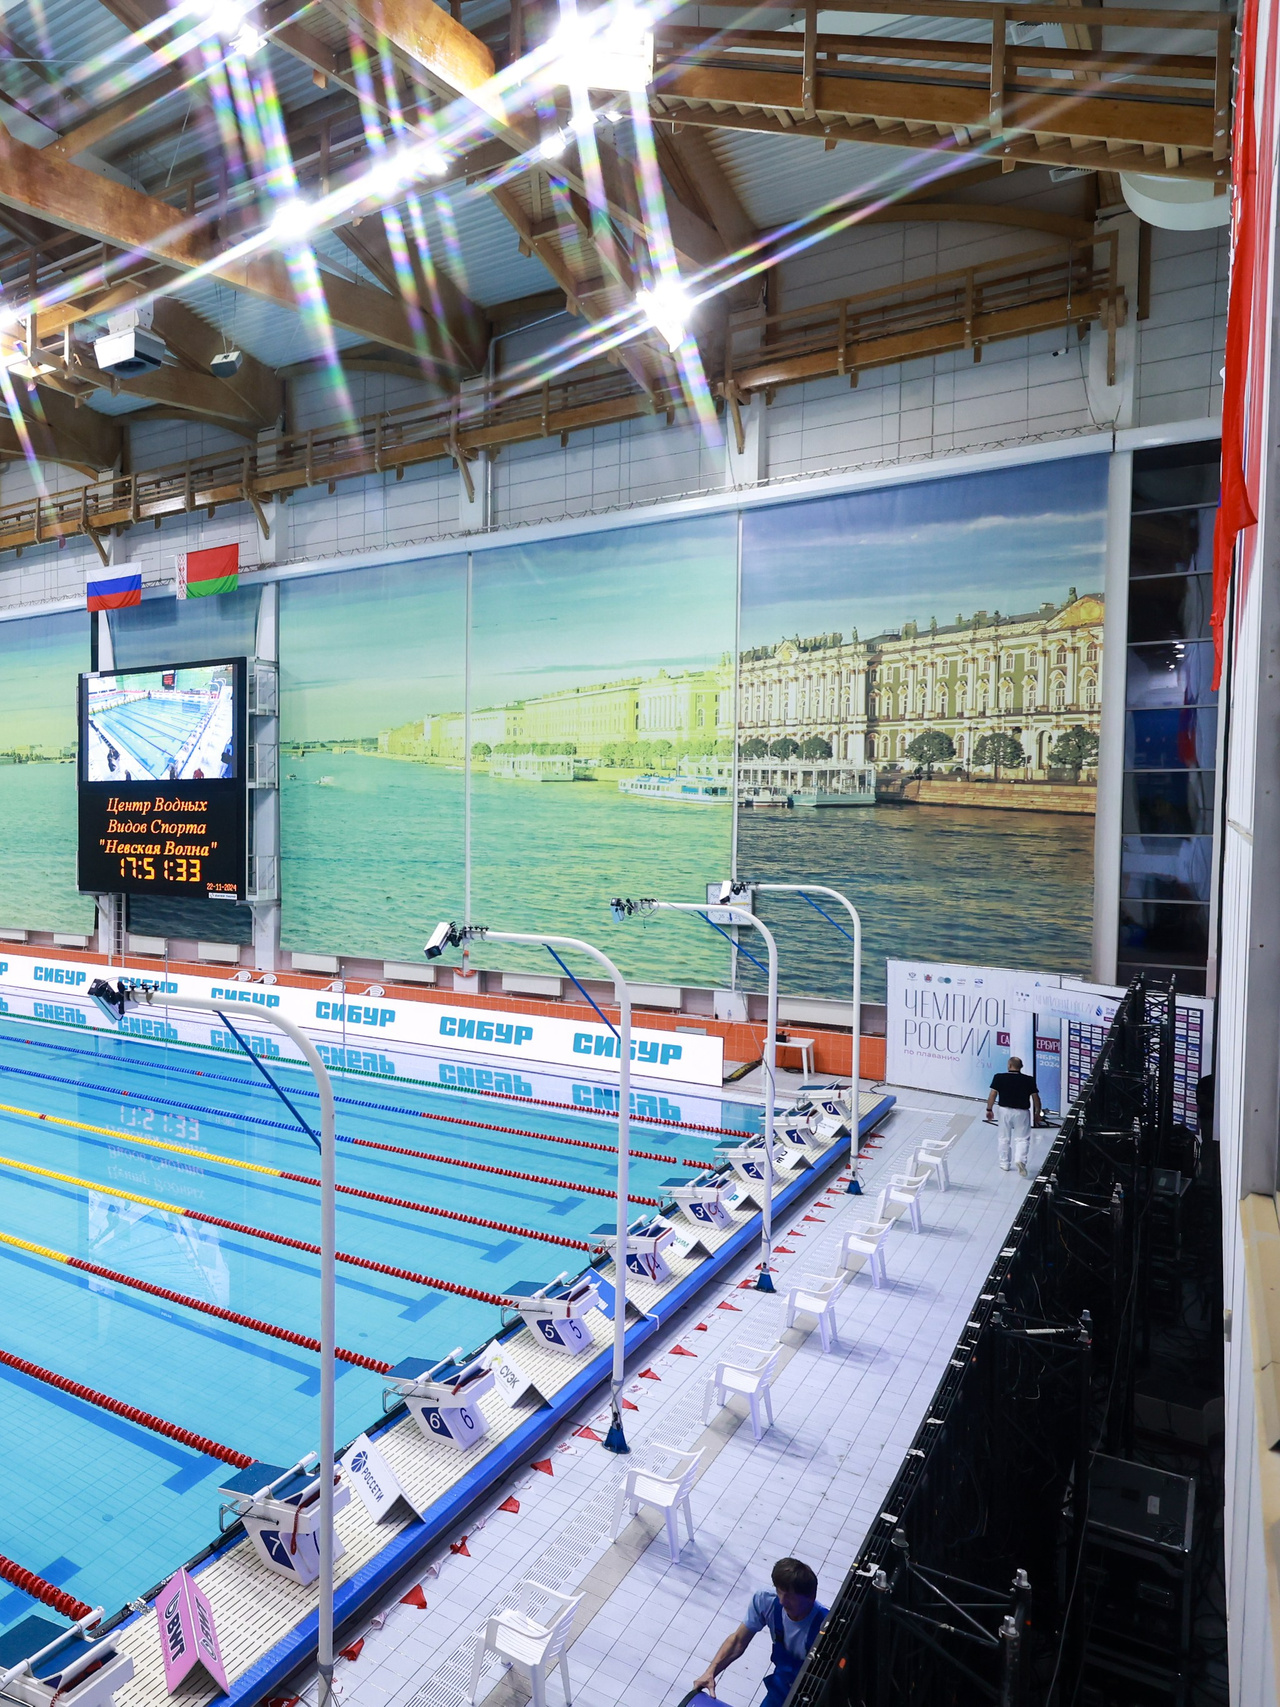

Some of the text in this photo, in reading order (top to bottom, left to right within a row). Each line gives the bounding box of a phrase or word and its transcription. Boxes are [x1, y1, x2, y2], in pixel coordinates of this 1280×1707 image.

[106, 797, 208, 815] Центр Водных
[107, 819, 206, 837] Видов Спорта
[100, 839, 218, 856] "Невская Волна"
[206, 882, 237, 892] 22-11-2024
[33, 966, 87, 986] СИБУР
[315, 1000, 396, 1027] СИБУР
[439, 1016, 533, 1046] СИБУР
[904, 1019, 991, 1058] РОССИИ
[572, 1032, 682, 1066] СИБУР
[916, 1051, 960, 1061] плаванию
[976, 1059, 985, 1068] 25
[827, 1104, 833, 1112] 0
[792, 1133, 798, 1142] 1
[749, 1167, 757, 1176] 2
[695, 1207, 704, 1218] 3
[630, 1261, 639, 1273] 4
[545, 1324, 554, 1339] 5
[569, 1320, 582, 1339] 5
[500, 1365, 520, 1389] СУЭК
[430, 1413, 440, 1429] 6
[460, 1407, 474, 1430] 6
[361, 1467, 384, 1502] РОССЕТИ
[270, 1536, 280, 1556] 7
[194, 1595, 213, 1646] BWT
[167, 1611, 186, 1662] BWT
